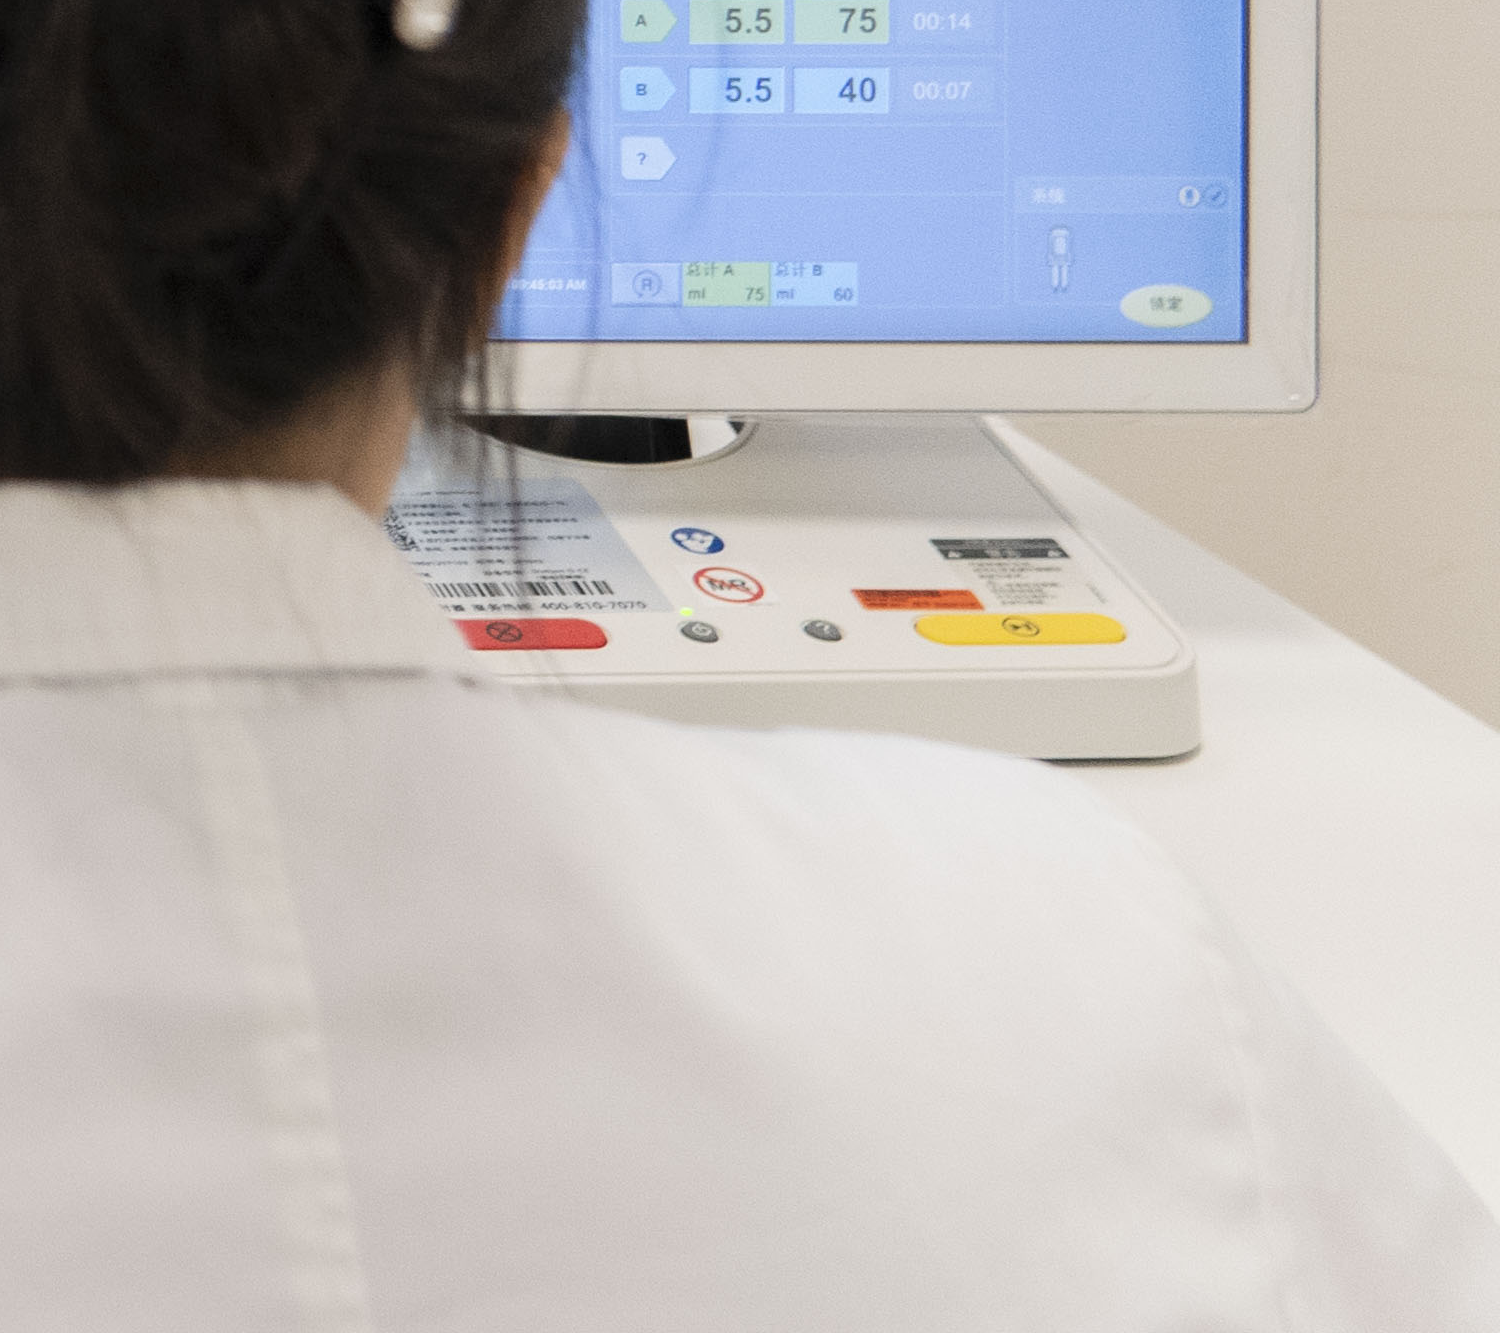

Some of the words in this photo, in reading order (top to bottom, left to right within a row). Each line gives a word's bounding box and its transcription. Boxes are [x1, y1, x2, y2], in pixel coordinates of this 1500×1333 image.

[634, 13, 648, 28] A
[724, 7, 773, 34] 5.5
[838, 7, 877, 34] 75
[913, 12, 971, 31] 00:14
[635, 83, 648, 97] B
[724, 76, 773, 104] 5.5
[837, 76, 877, 104] 40
[913, 81, 972, 101] 00:07
[723, 265, 735, 277] A
[744, 287, 765, 302] 75
[833, 287, 853, 302] 60
